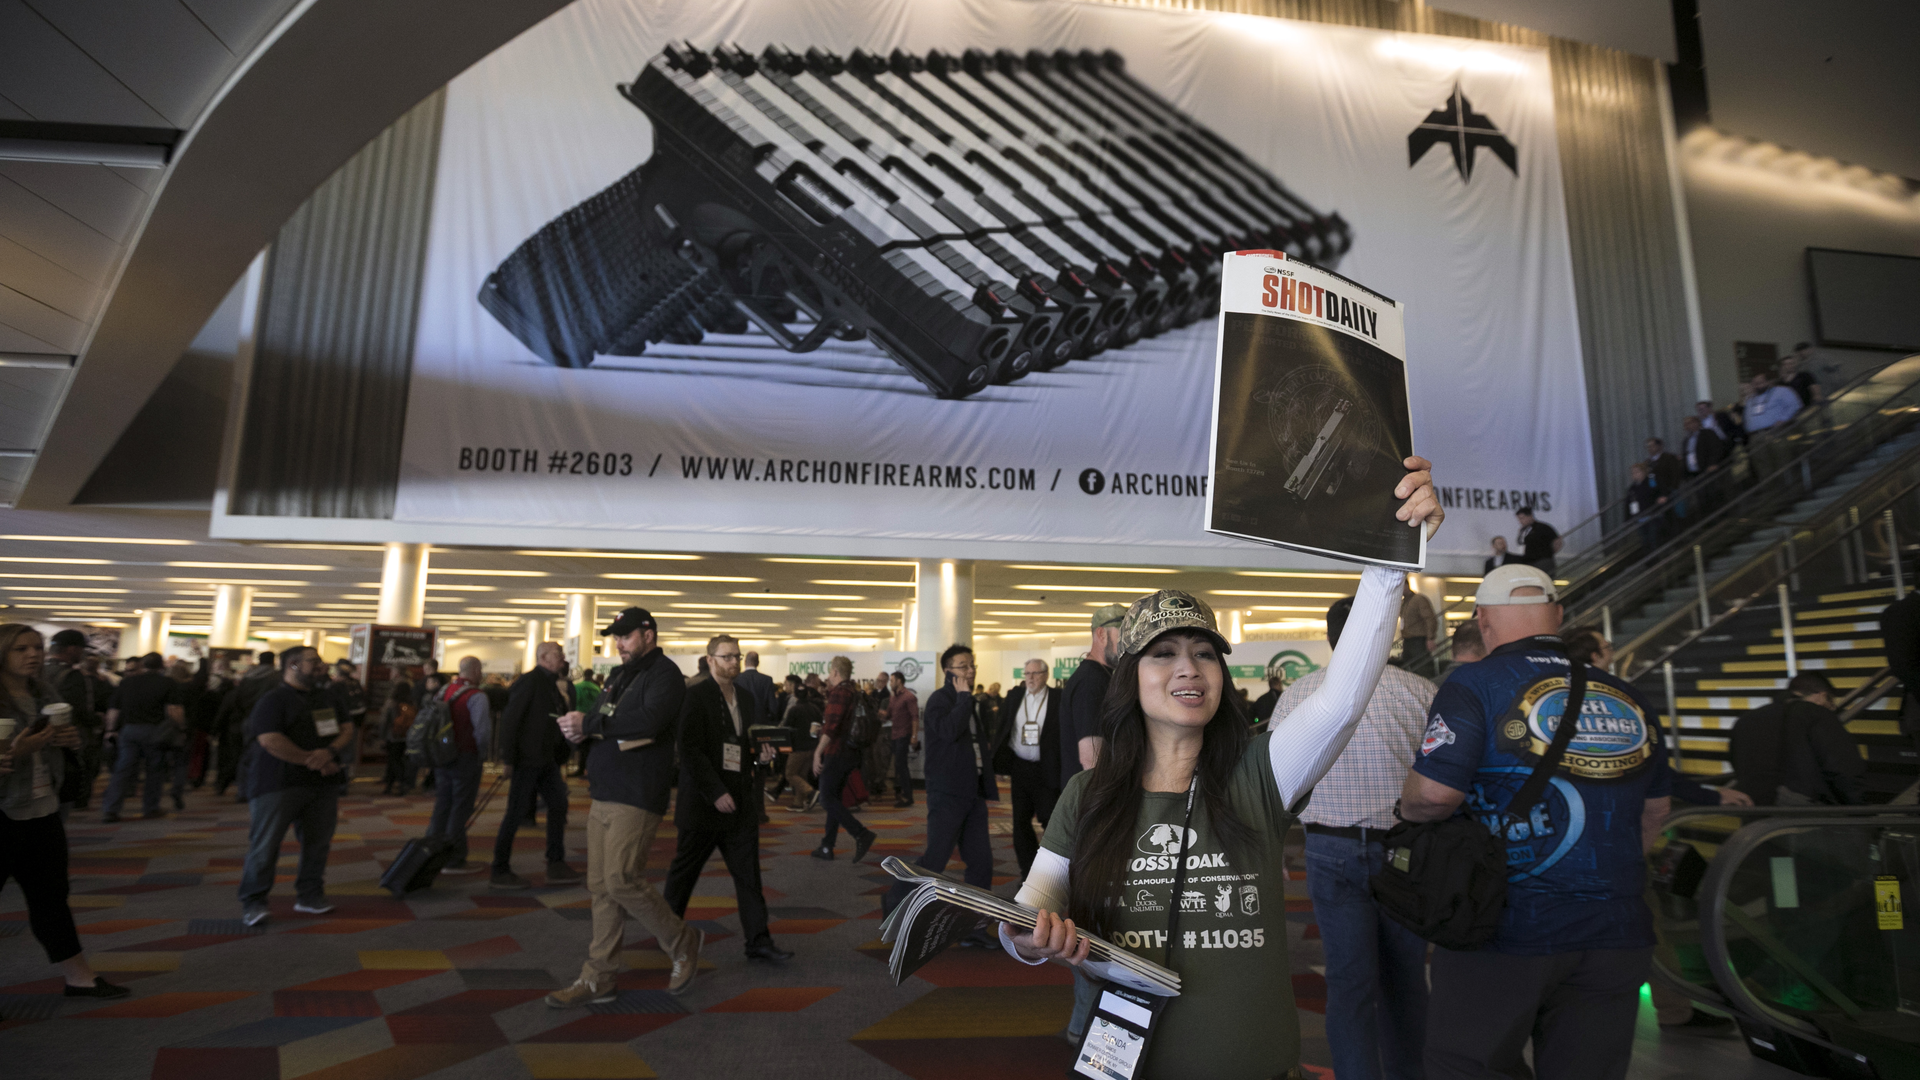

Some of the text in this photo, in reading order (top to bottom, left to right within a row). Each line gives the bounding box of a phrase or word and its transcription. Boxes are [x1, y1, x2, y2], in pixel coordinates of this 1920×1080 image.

[1277, 268, 1294, 277] NSSF
[458, 447, 539, 472] BOOTH
[547, 452, 633, 477] #2603
[681, 456, 1036, 491] WWW.ARCHONFIREARMS.COM
[789, 661, 826, 675] DOMESTIC
[1531, 679, 1563, 696] WORLD
[1507, 723, 1524, 738] SIG
[1126, 856, 1179, 872] OSSY
[1188, 876, 1199, 884] OF
[1111, 928, 1265, 949] OOTH #11035
[1102, 1031, 1127, 1050] GLENDA
